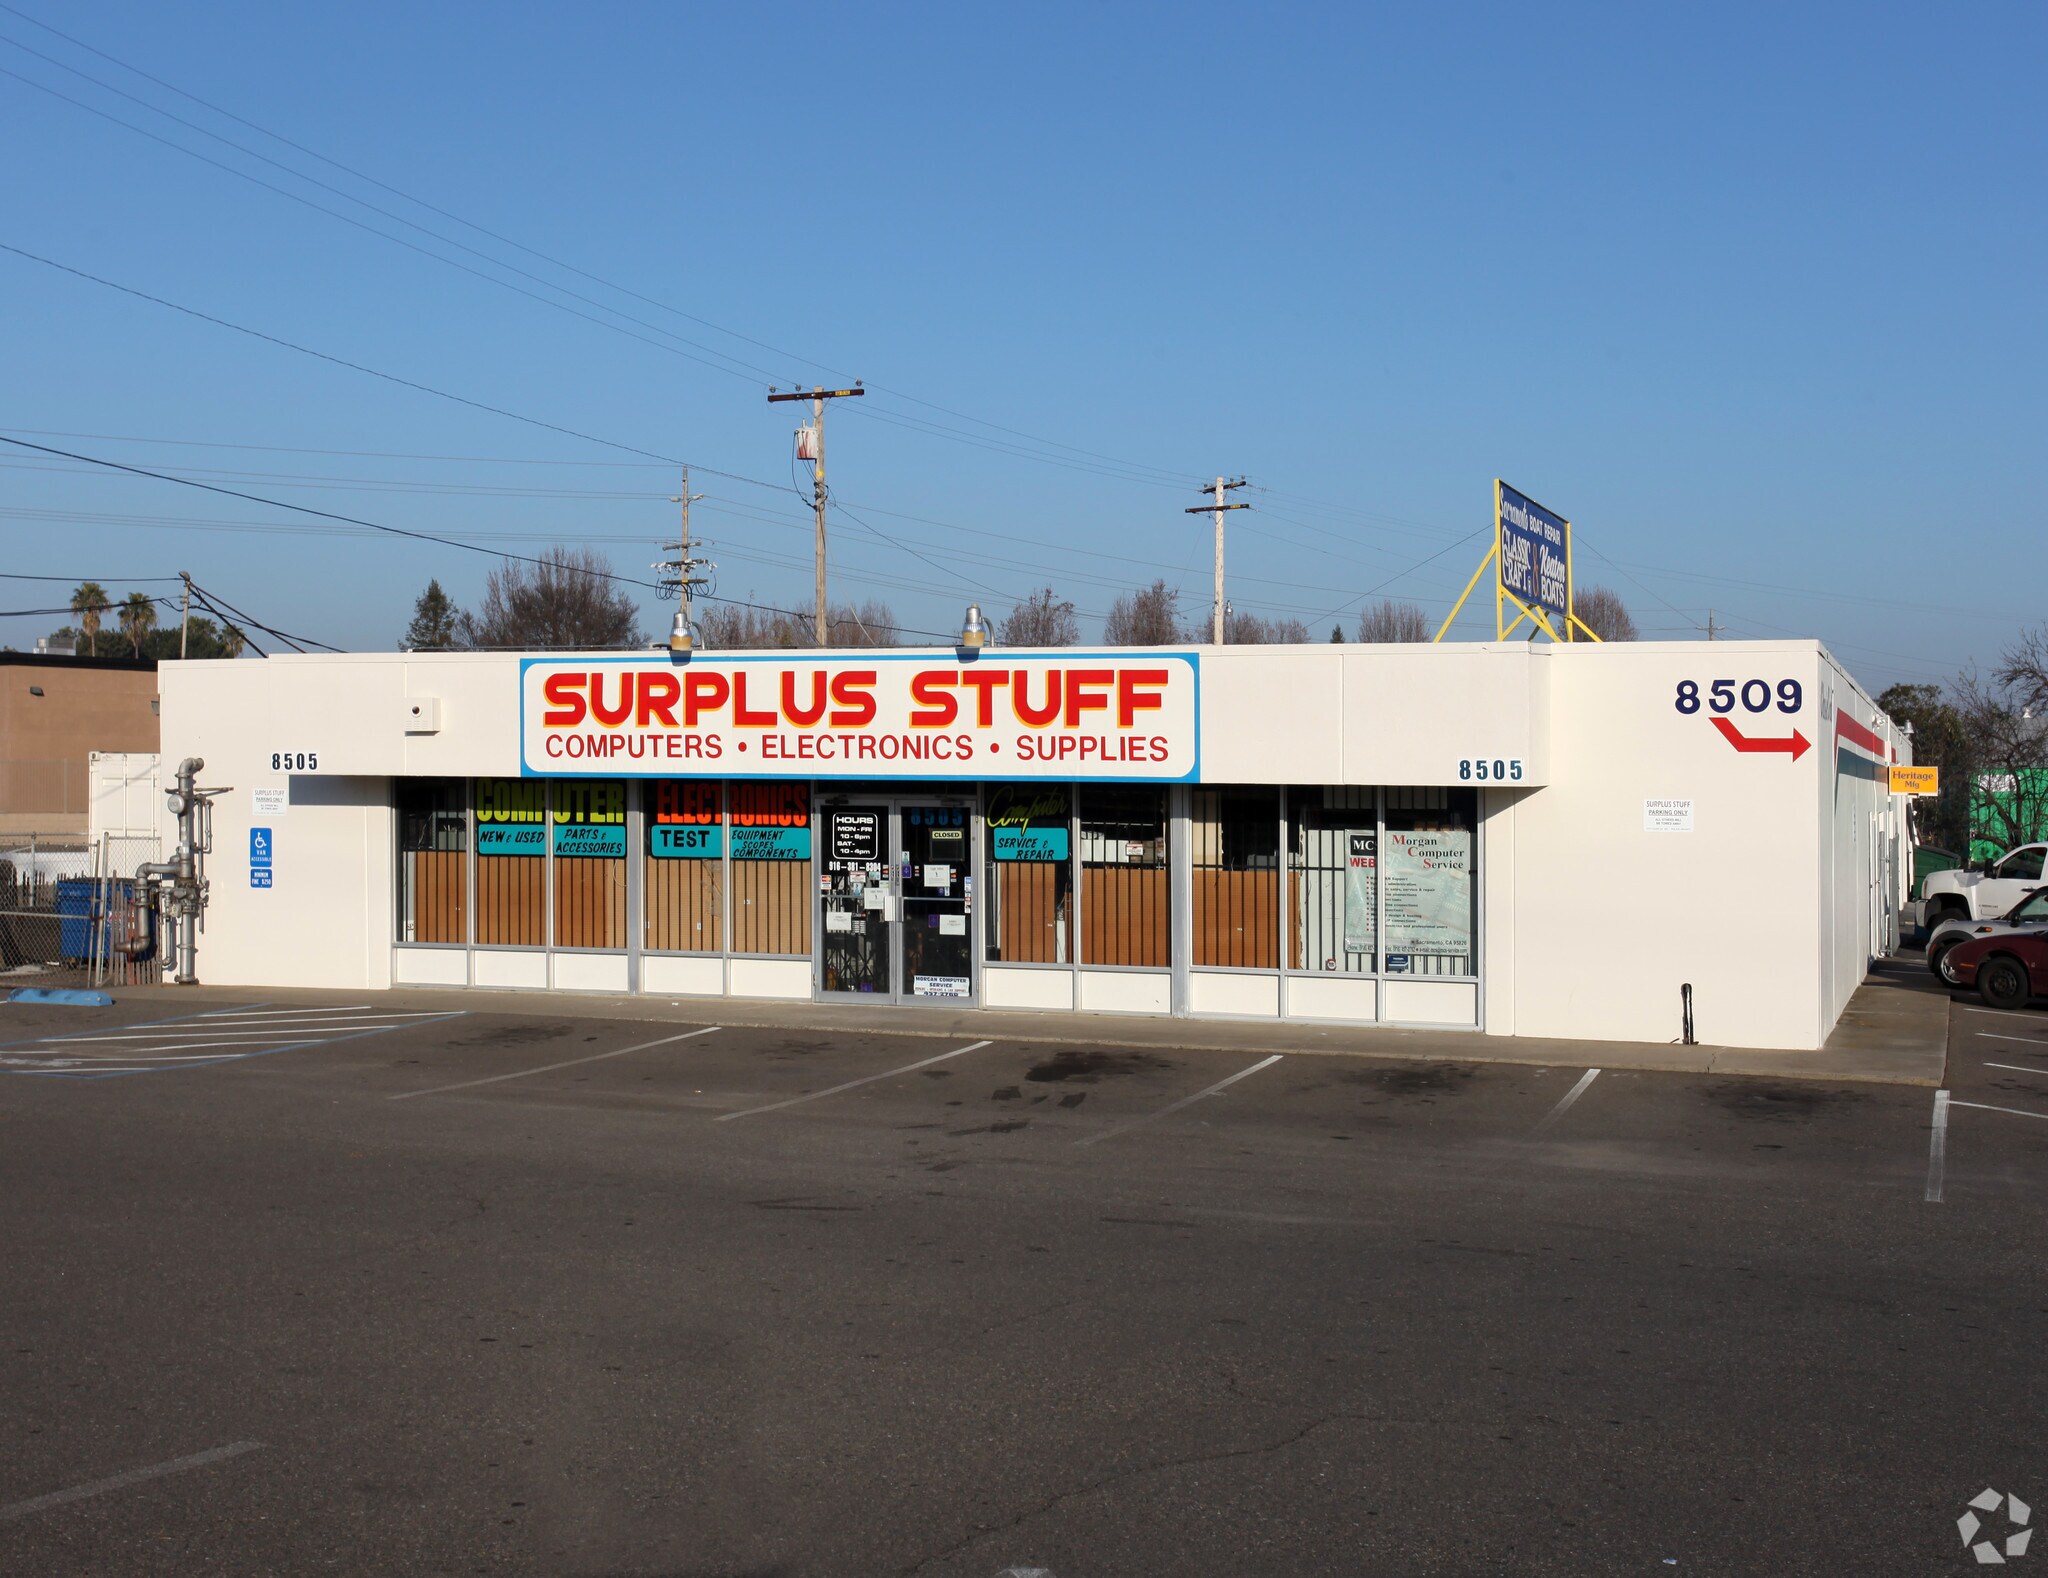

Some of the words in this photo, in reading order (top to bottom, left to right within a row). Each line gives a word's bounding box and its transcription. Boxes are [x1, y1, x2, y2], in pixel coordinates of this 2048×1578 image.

[1529, 514, 1543, 537] BOAT
[1544, 522, 1561, 547] REPAIR
[1502, 525, 1531, 570] CLASSIC
[1502, 544, 1528, 592] CRAFT
[1541, 575, 1565, 609] BOATS
[543, 671, 877, 729] SURPLUS
[909, 669, 1169, 729] STUFF
[1674, 678, 1803, 715] 8509
[545, 734, 723, 760] COMPUTERS
[762, 734, 974, 761] ELECTRONICS
[1016, 735, 1169, 762] SUPPLIES
[271, 752, 318, 771] 8505
[1459, 759, 1523, 780] 8505
[1892, 771, 1934, 782] Heritage
[1904, 781, 1920, 790] Mfg
[476, 779, 624, 824] COMPUTER
[657, 780, 807, 827] ELECTRONICS
[1646, 800, 1672, 808] SURPLUS
[1673, 800, 1690, 808] STUFF
[836, 816, 874, 824] HOURS
[910, 807, 963, 826] 8505
[480, 831, 505, 843] NEW
[515, 831, 545, 844] USED
[564, 828, 599, 840] PARTS
[660, 829, 710, 847] TEST
[732, 830, 785, 841] EQUIPMENT
[1392, 834, 1437, 847] Morgan
[556, 842, 622, 854] ACCESSORIES
[743, 841, 774, 849] SCOPES
[997, 837, 1038, 849] SERVICE
[1353, 840, 1376, 851] MC
[733, 848, 799, 858] COMPONENTS
[1016, 849, 1055, 860] REPAIR
[1407, 846, 1465, 859] Computer
[1423, 858, 1464, 869] Service
